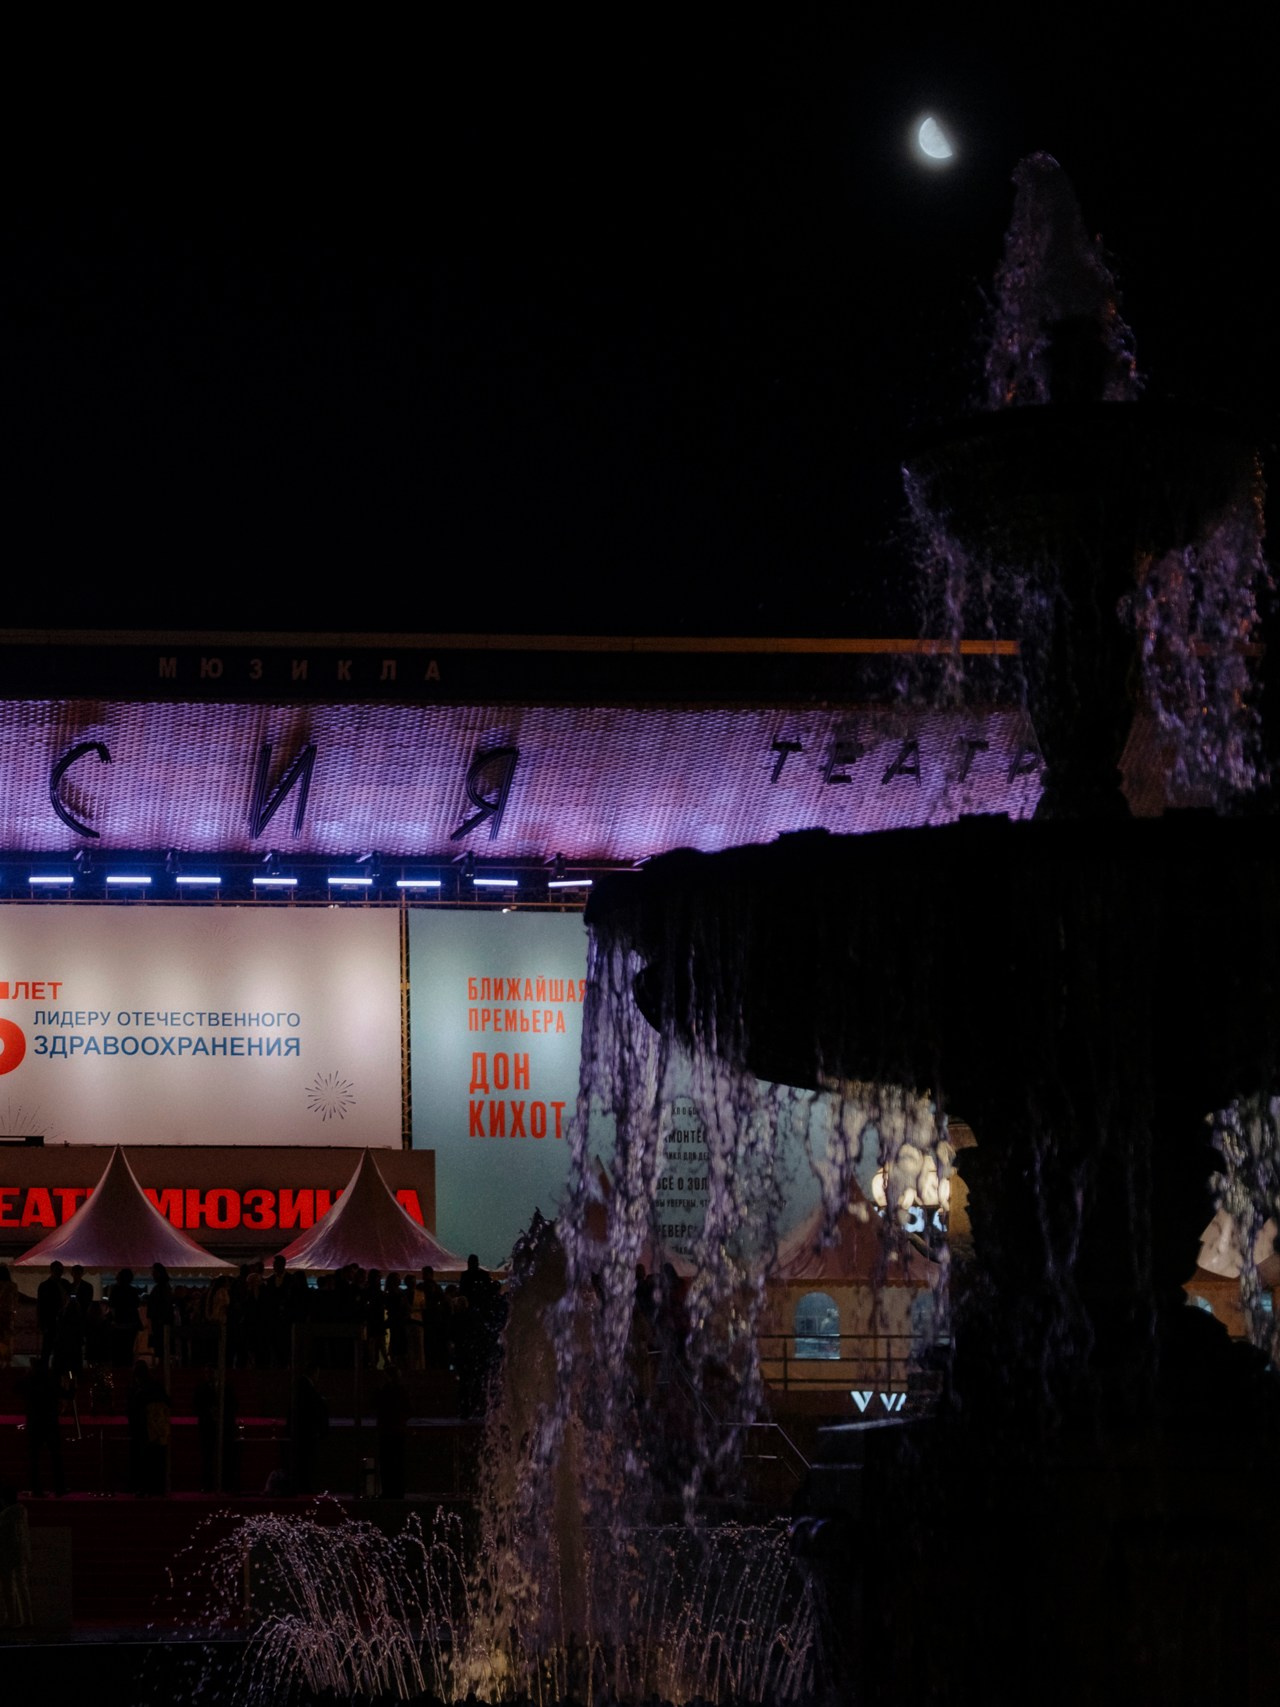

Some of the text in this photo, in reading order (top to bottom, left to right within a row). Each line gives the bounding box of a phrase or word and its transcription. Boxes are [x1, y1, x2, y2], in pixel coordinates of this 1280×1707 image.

[158, 655, 443, 683] МЮЗИКЛА
[11, 981, 64, 1001] ЛЕТ
[467, 975, 588, 1004] БЛИЖАЙШАЯ
[33, 1010, 302, 1028] ЛИДЕРУ ОТЕЧЕСТВЕННОГО
[468, 1007, 567, 1034] ПРЕМЬЕРА
[32, 1035, 302, 1060] ЗДРАВООХРАНЕНИЯ
[469, 1051, 531, 1095] ДОН
[469, 1098, 567, 1140] КИХОТ
